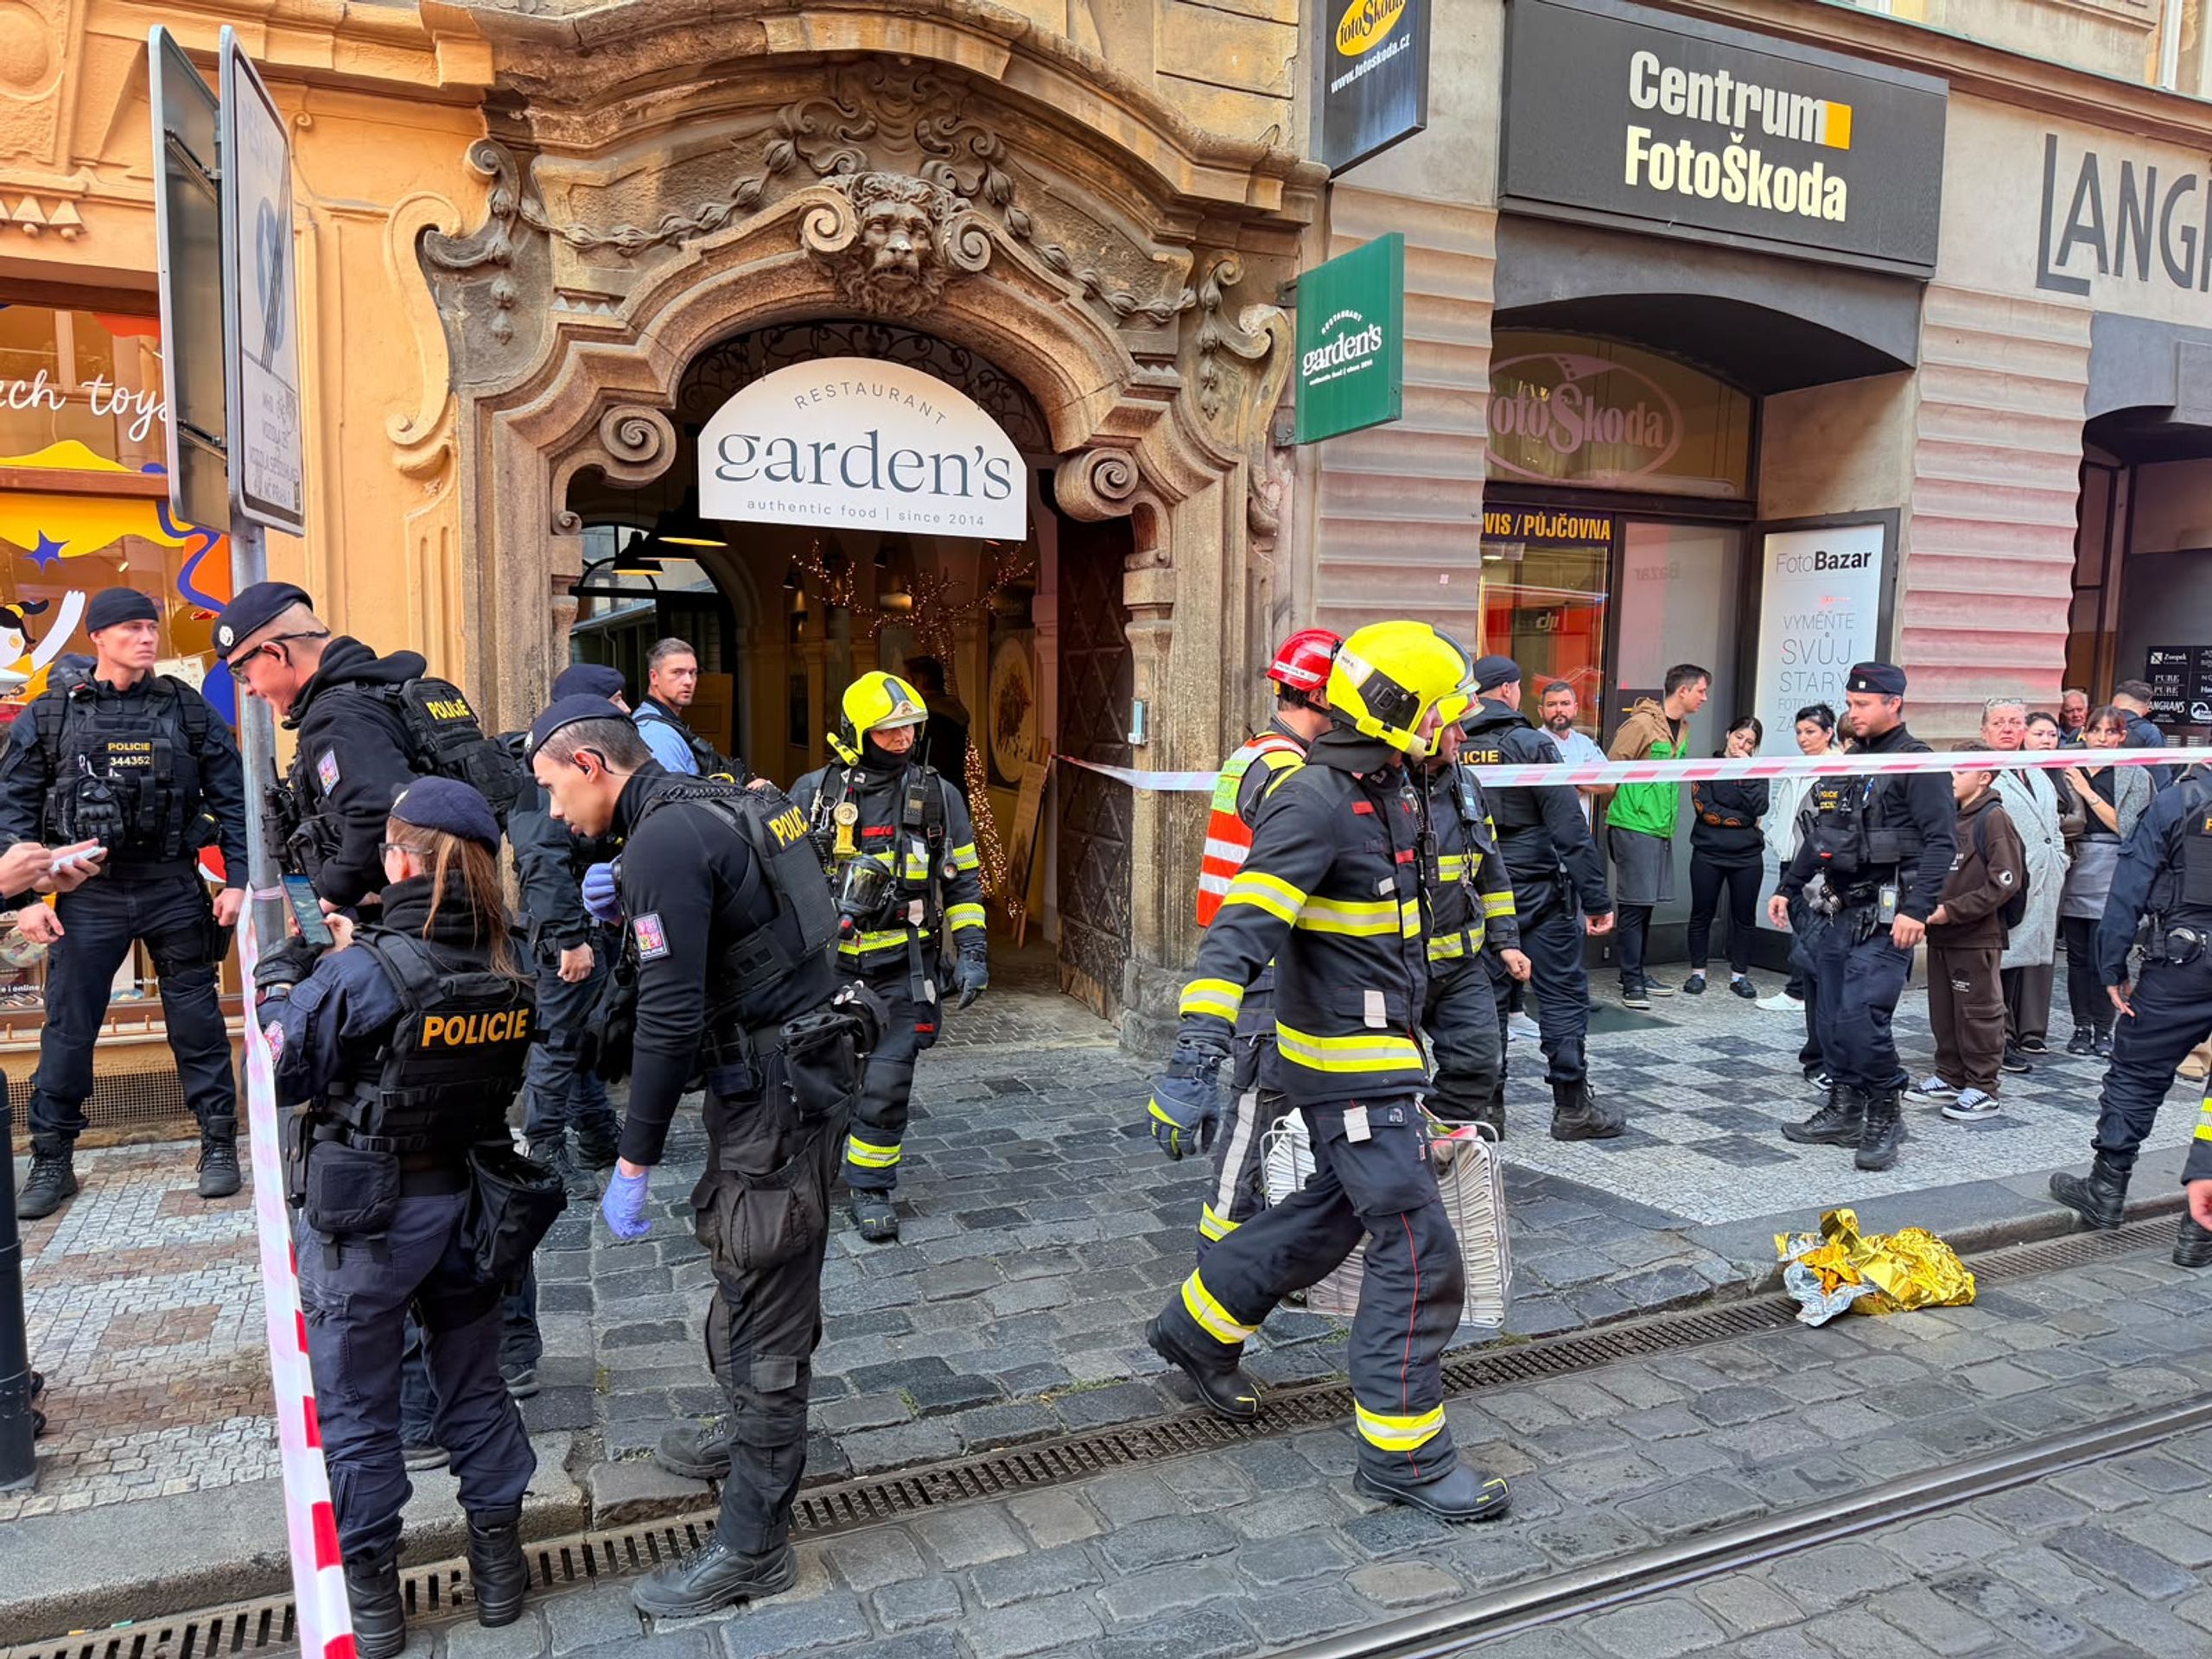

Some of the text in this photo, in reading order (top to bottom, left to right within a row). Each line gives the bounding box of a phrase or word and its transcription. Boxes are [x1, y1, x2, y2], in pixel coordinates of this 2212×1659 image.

[1331, 33, 1410, 94] www.fotoskoda.cz
[1630, 50, 1828, 145] Centrum
[1624, 124, 1847, 222] FotoŠkoda
[1302, 323, 1382, 377] garden's
[794, 381, 946, 426] RESTAURANT
[715, 429, 1013, 500] garden's
[747, 498, 832, 516] authentic
[841, 503, 878, 518] food
[898, 510, 941, 524] since
[949, 513, 984, 526] 2014
[1523, 511, 1611, 541] PŮJČOVNA
[1776, 551, 1872, 574] FotoBazar
[1783, 610, 1856, 631] VYMĚŇTE
[1780, 631, 1853, 665] SVŮJ
[426, 698, 470, 721] POLICIE
[107, 742, 150, 751] POLICIE
[110, 755, 151, 766] 344352
[422, 1007, 530, 1047] POLICIE
